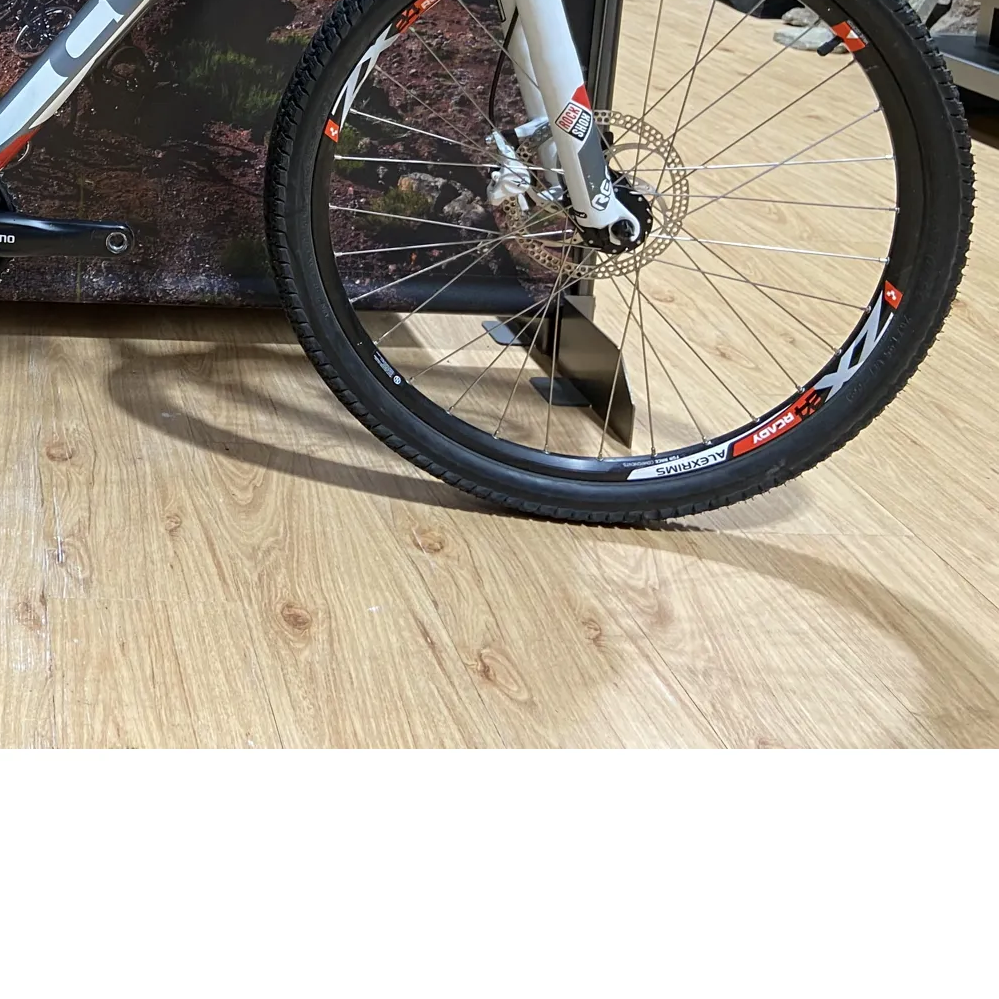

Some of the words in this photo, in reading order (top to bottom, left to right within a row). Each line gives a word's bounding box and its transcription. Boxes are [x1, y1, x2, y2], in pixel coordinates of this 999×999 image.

[560, 107, 581, 132] ROCK
[571, 112, 593, 139] SHOX
[753, 412, 795, 444] READY
[656, 449, 725, 477] ALEXRIMS
